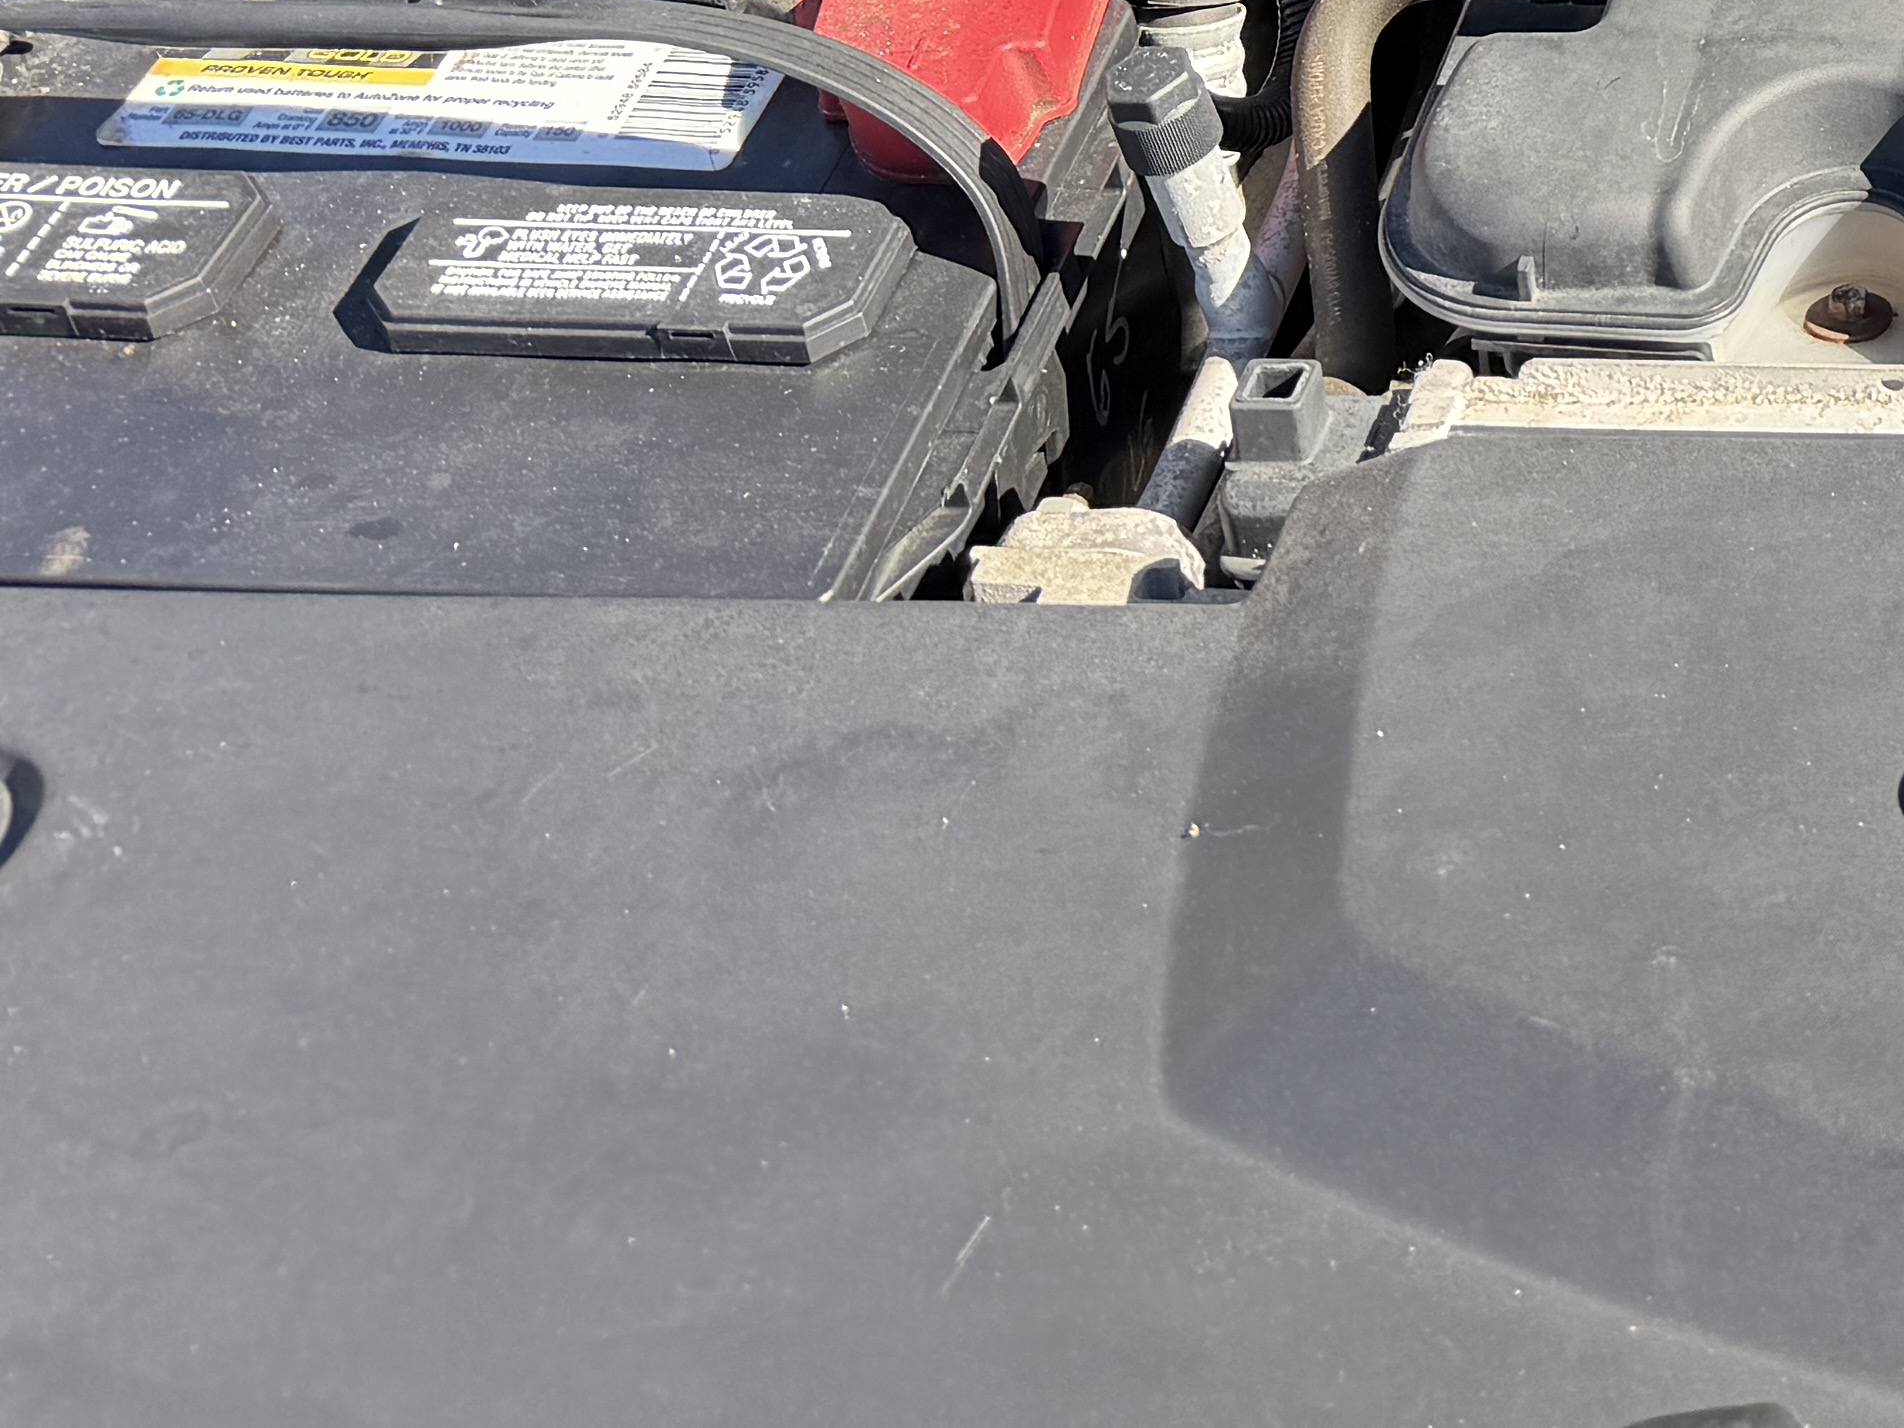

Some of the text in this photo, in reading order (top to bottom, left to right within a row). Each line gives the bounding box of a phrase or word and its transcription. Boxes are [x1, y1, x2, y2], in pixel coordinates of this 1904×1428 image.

[308, 49, 412, 63] GOLD
[201, 64, 373, 80] PROVEN TOUGH
[188, 84, 235, 95] Return
[238, 86, 270, 95] used
[274, 87, 334, 99] batteries
[357, 91, 420, 103] AutoZone
[422, 94, 441, 103] for
[443, 95, 490, 106] proper
[493, 99, 556, 110] recycling
[173, 107, 244, 122] 65-DLG
[326, 112, 379, 129] 850
[441, 120, 484, 133] 1000
[179, 130, 259, 143] DISTRIBUTED
[261, 134, 278, 144] BY
[280, 134, 314, 145] BEST
[316, 136, 356, 148] PARTS,
[390, 139, 450, 154] MEMPHIS,
[454, 142, 471, 153] TN
[56, 176, 183, 199] POISON
[62, 235, 187, 255] SULFURIC ACID
[512, 229, 695, 246] FLUSH EYES IMMEDIATELY
[498, 250, 640, 265] MEDICAL HELP FAST
